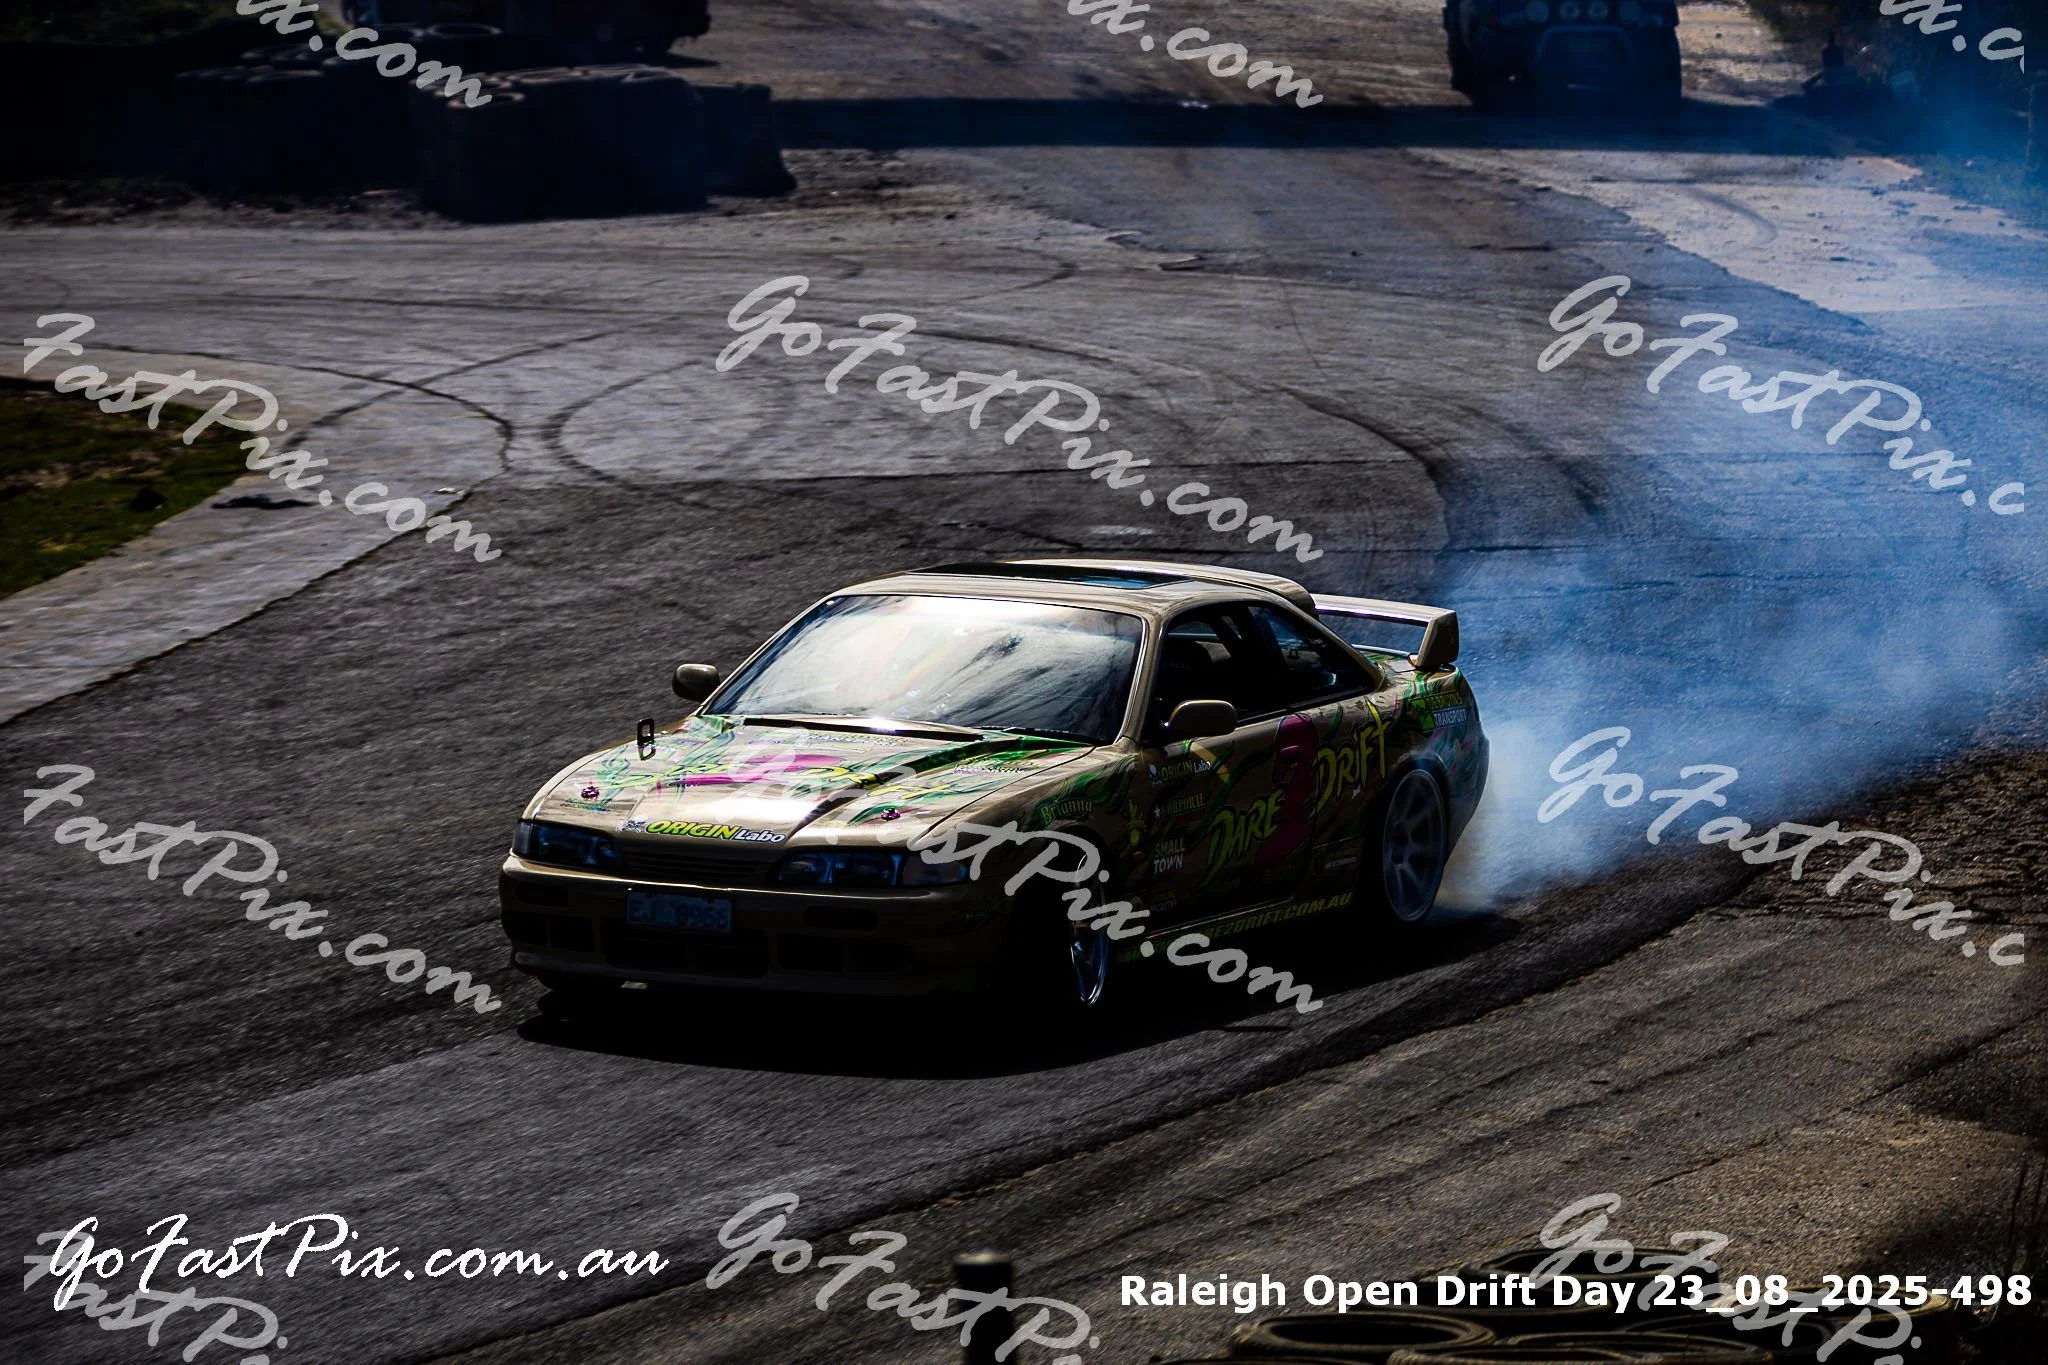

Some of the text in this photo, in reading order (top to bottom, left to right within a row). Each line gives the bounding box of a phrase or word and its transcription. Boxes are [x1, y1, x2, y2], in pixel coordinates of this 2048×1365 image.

[1161, 760, 1193, 782] ORIGIN
[1197, 788, 1284, 888] DARE
[1307, 696, 1393, 822] DRIFT
[646, 819, 787, 845] ORIGIN Labo
[1153, 838, 1184, 858] SMALL
[1153, 855, 1184, 875] TOWN
